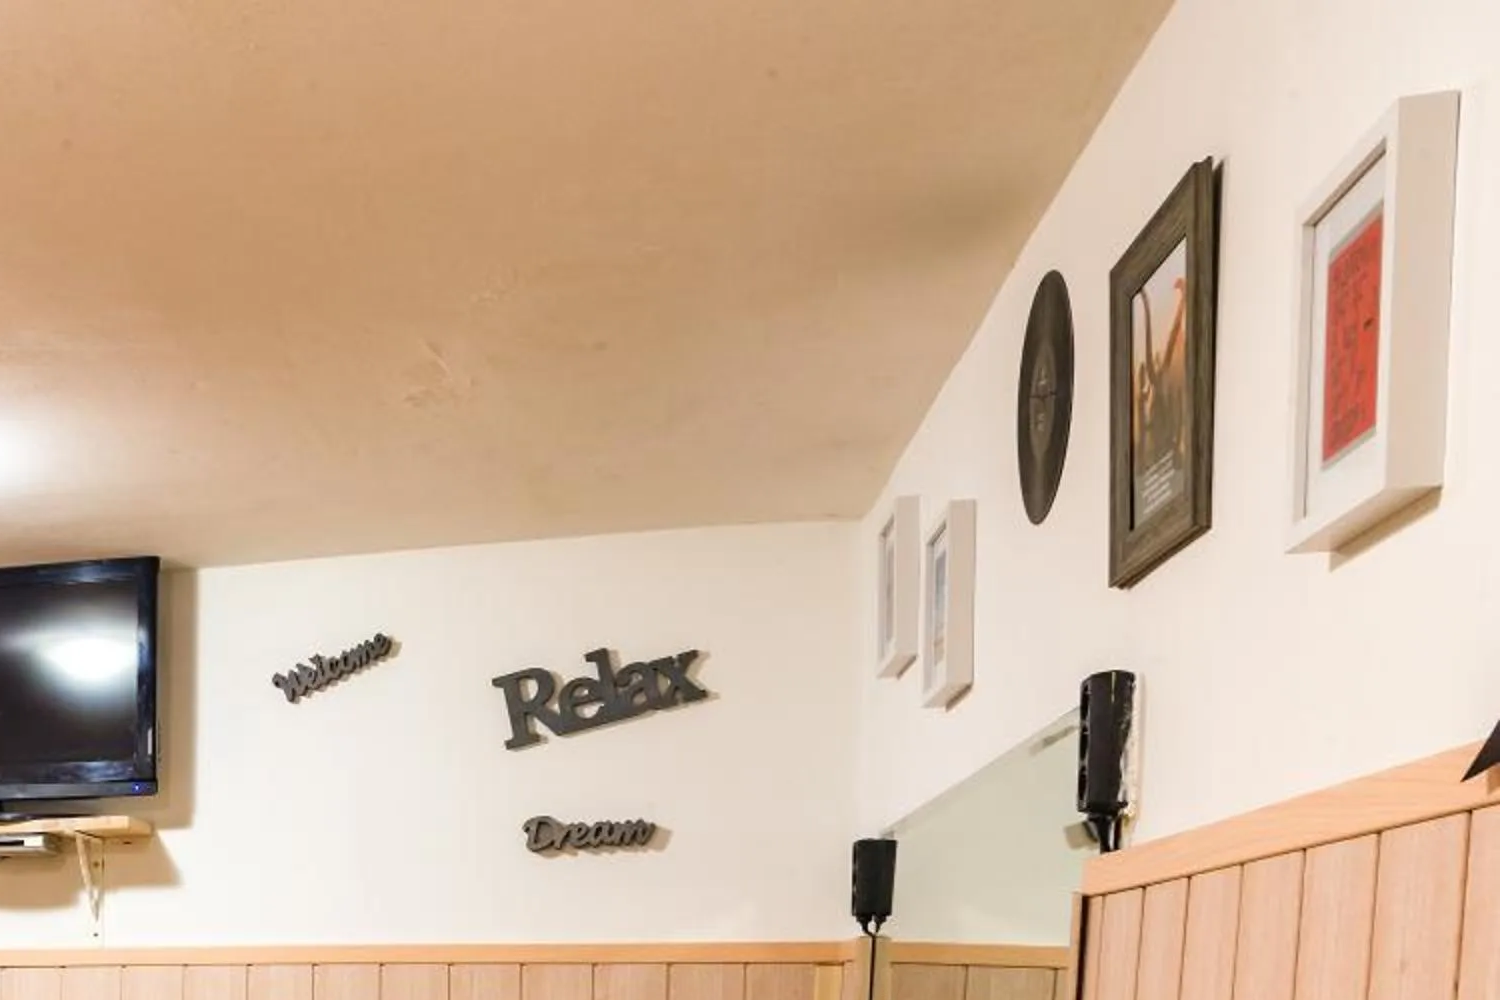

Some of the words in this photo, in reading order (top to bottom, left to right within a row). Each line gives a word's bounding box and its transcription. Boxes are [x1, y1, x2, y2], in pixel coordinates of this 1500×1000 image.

[272, 633, 392, 704] Welcome
[492, 648, 708, 750] Relax
[522, 816, 656, 852] Dream
